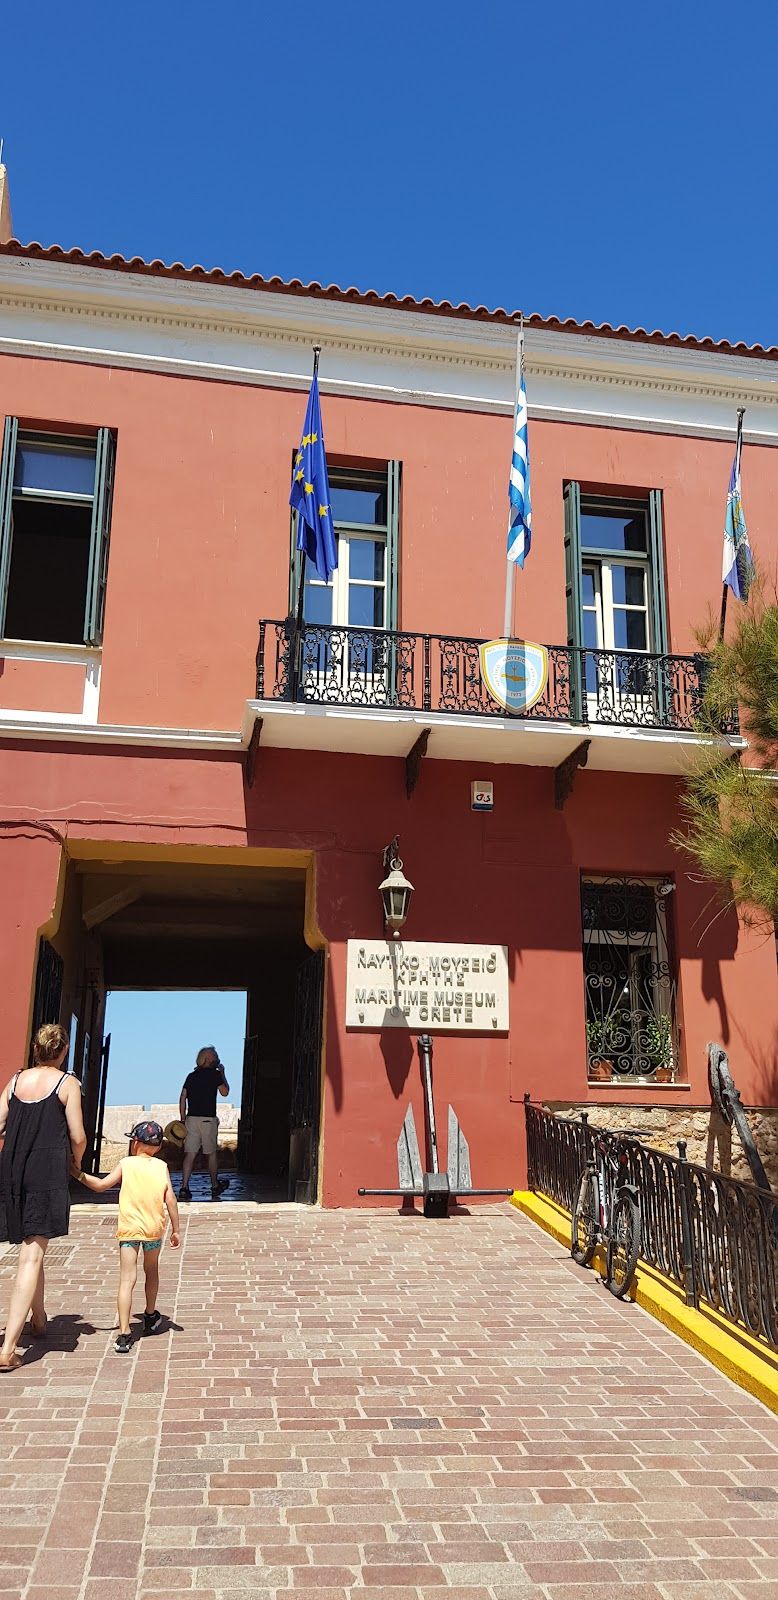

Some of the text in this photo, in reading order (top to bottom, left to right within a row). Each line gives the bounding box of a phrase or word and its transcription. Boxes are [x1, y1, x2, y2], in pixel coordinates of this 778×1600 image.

[357, 954, 497, 973] ΝΑΥΤΙΚΟ ΜΟΥΣΕΙΟ
[397, 971, 464, 986] ΚΡΗΤΗΣ
[355, 989, 496, 1007] MARITIME MUSEUM
[419, 1007, 473, 1023] CRETE
